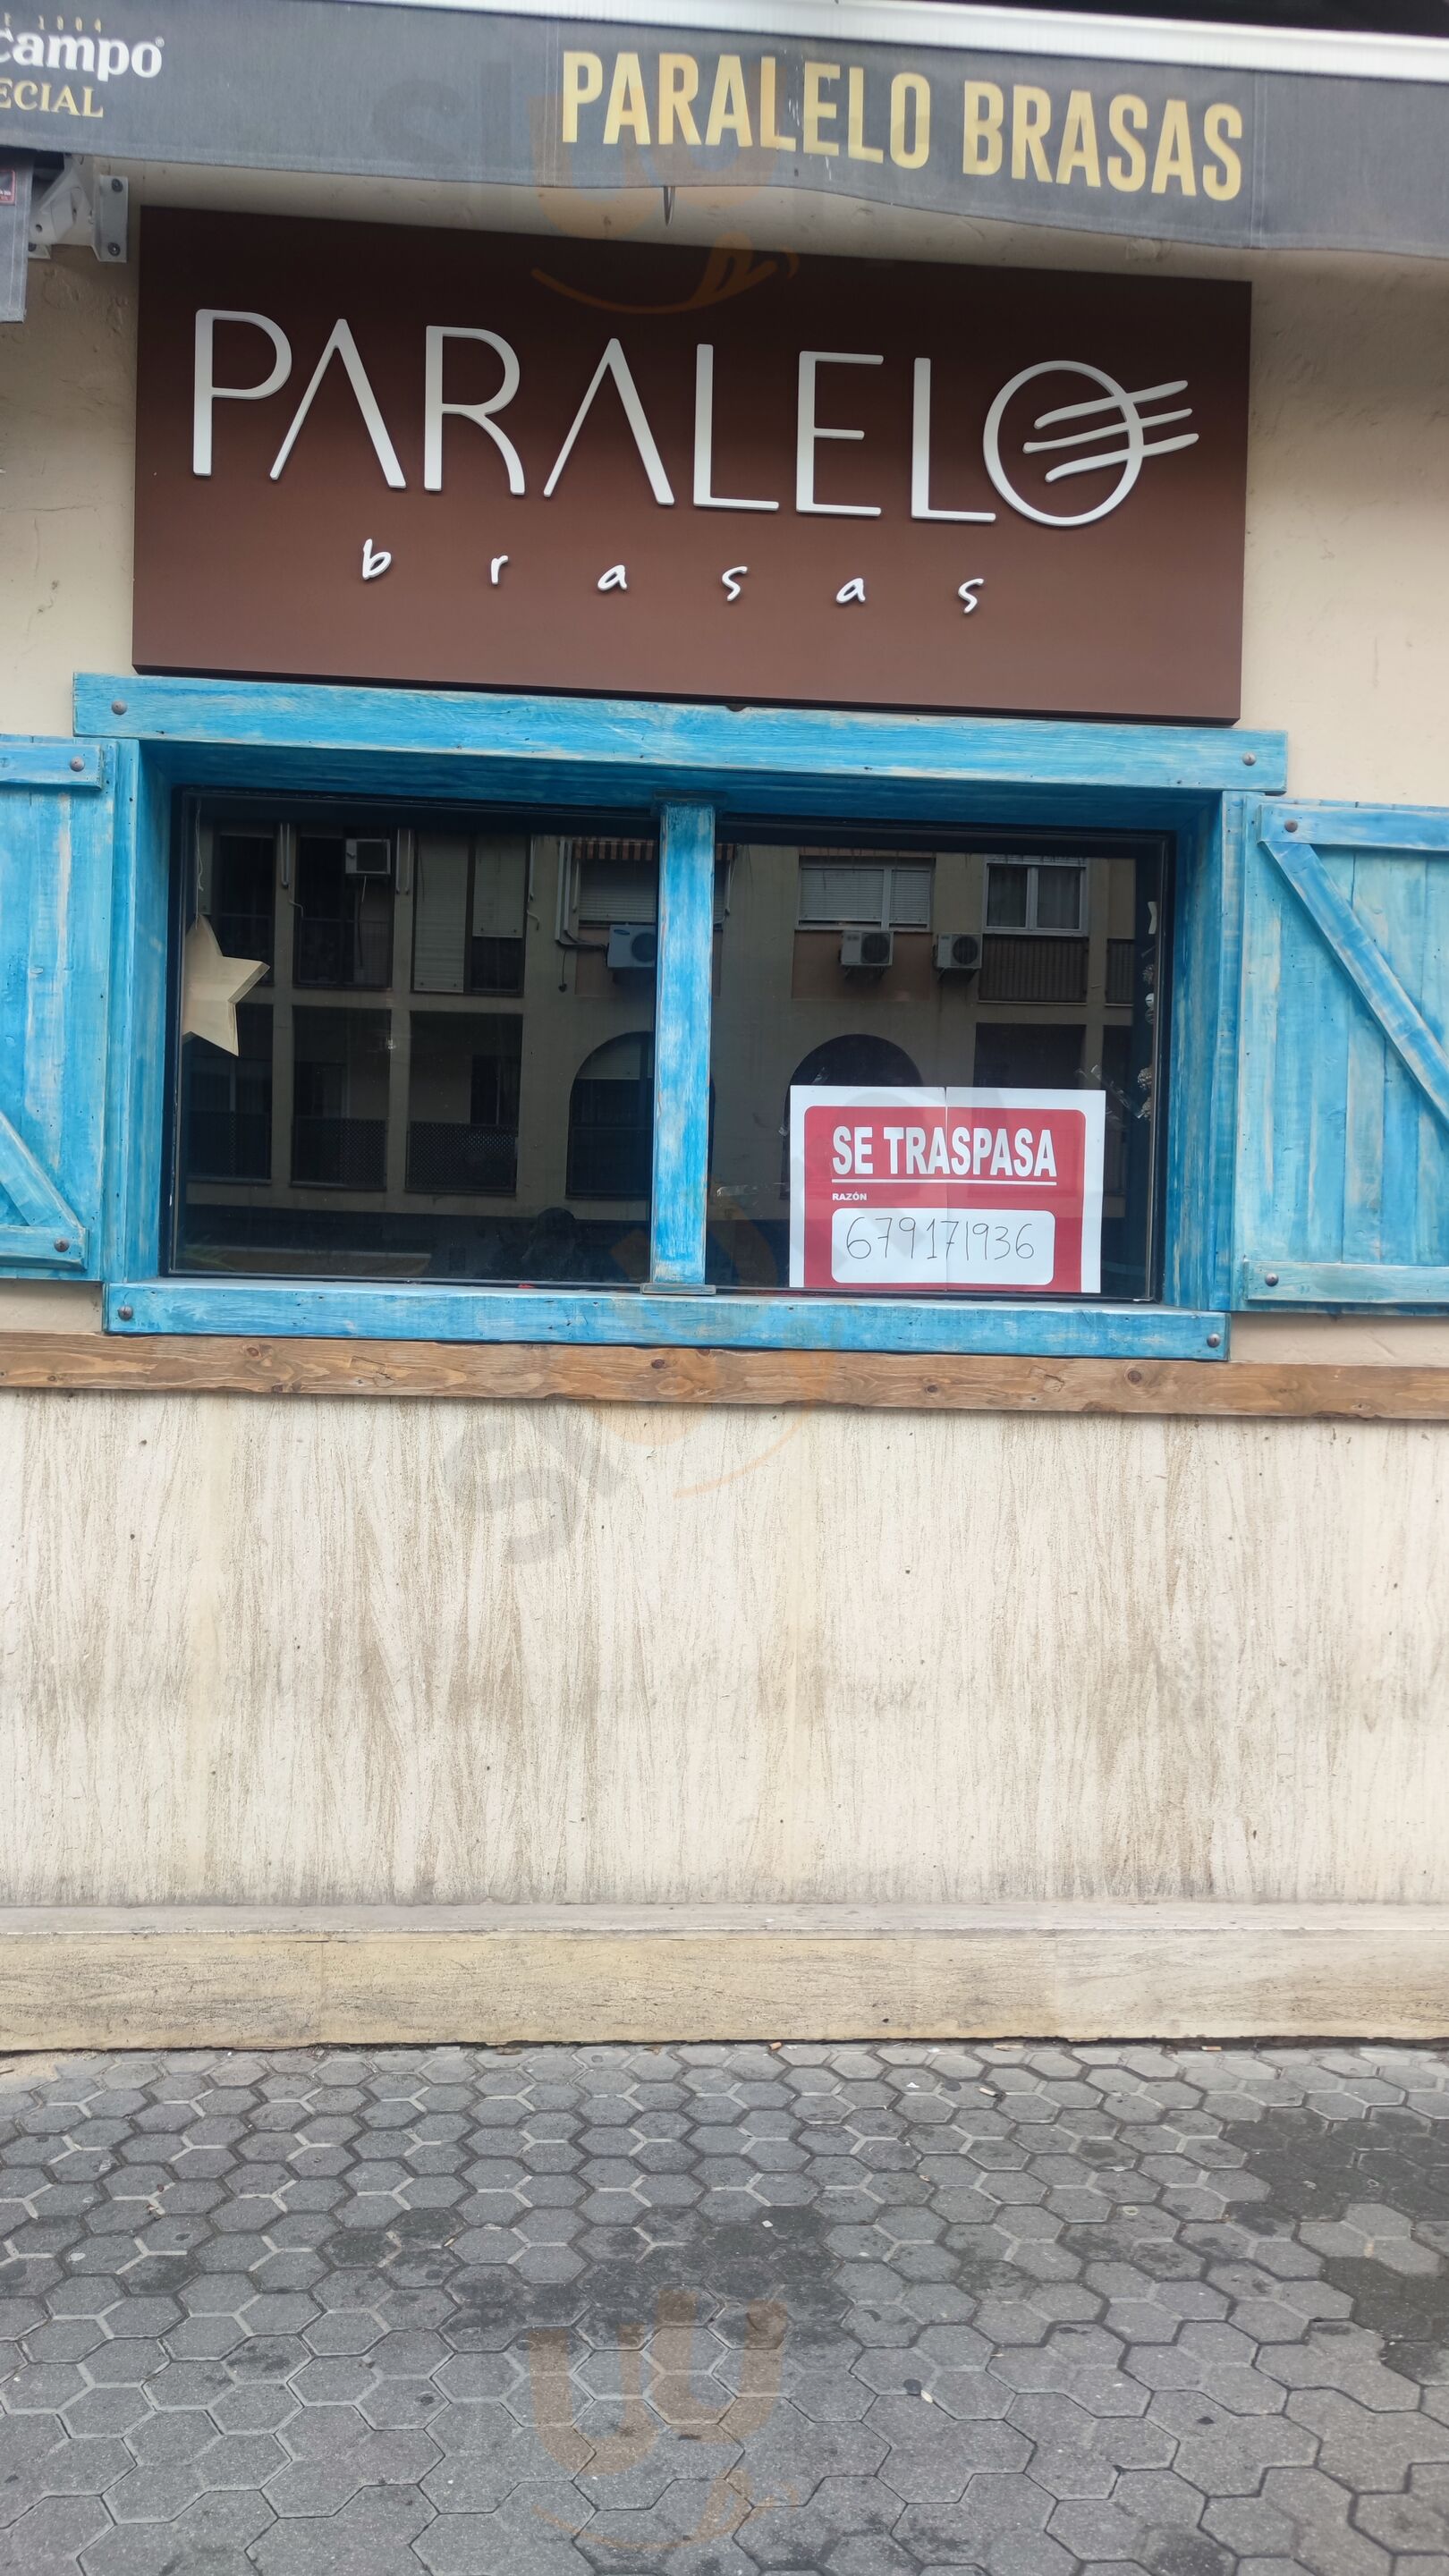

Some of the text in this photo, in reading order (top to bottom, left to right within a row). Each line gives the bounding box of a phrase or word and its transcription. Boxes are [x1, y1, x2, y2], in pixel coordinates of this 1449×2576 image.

[562, 51, 1242, 201] PARALELO BRASAS
[191, 308, 1200, 528] PARALELO
[832, 1125, 1057, 1177] SE TRASPASA
[832, 1191, 868, 1201] RAZÓN
[845, 1216, 1035, 1261] 679171936
